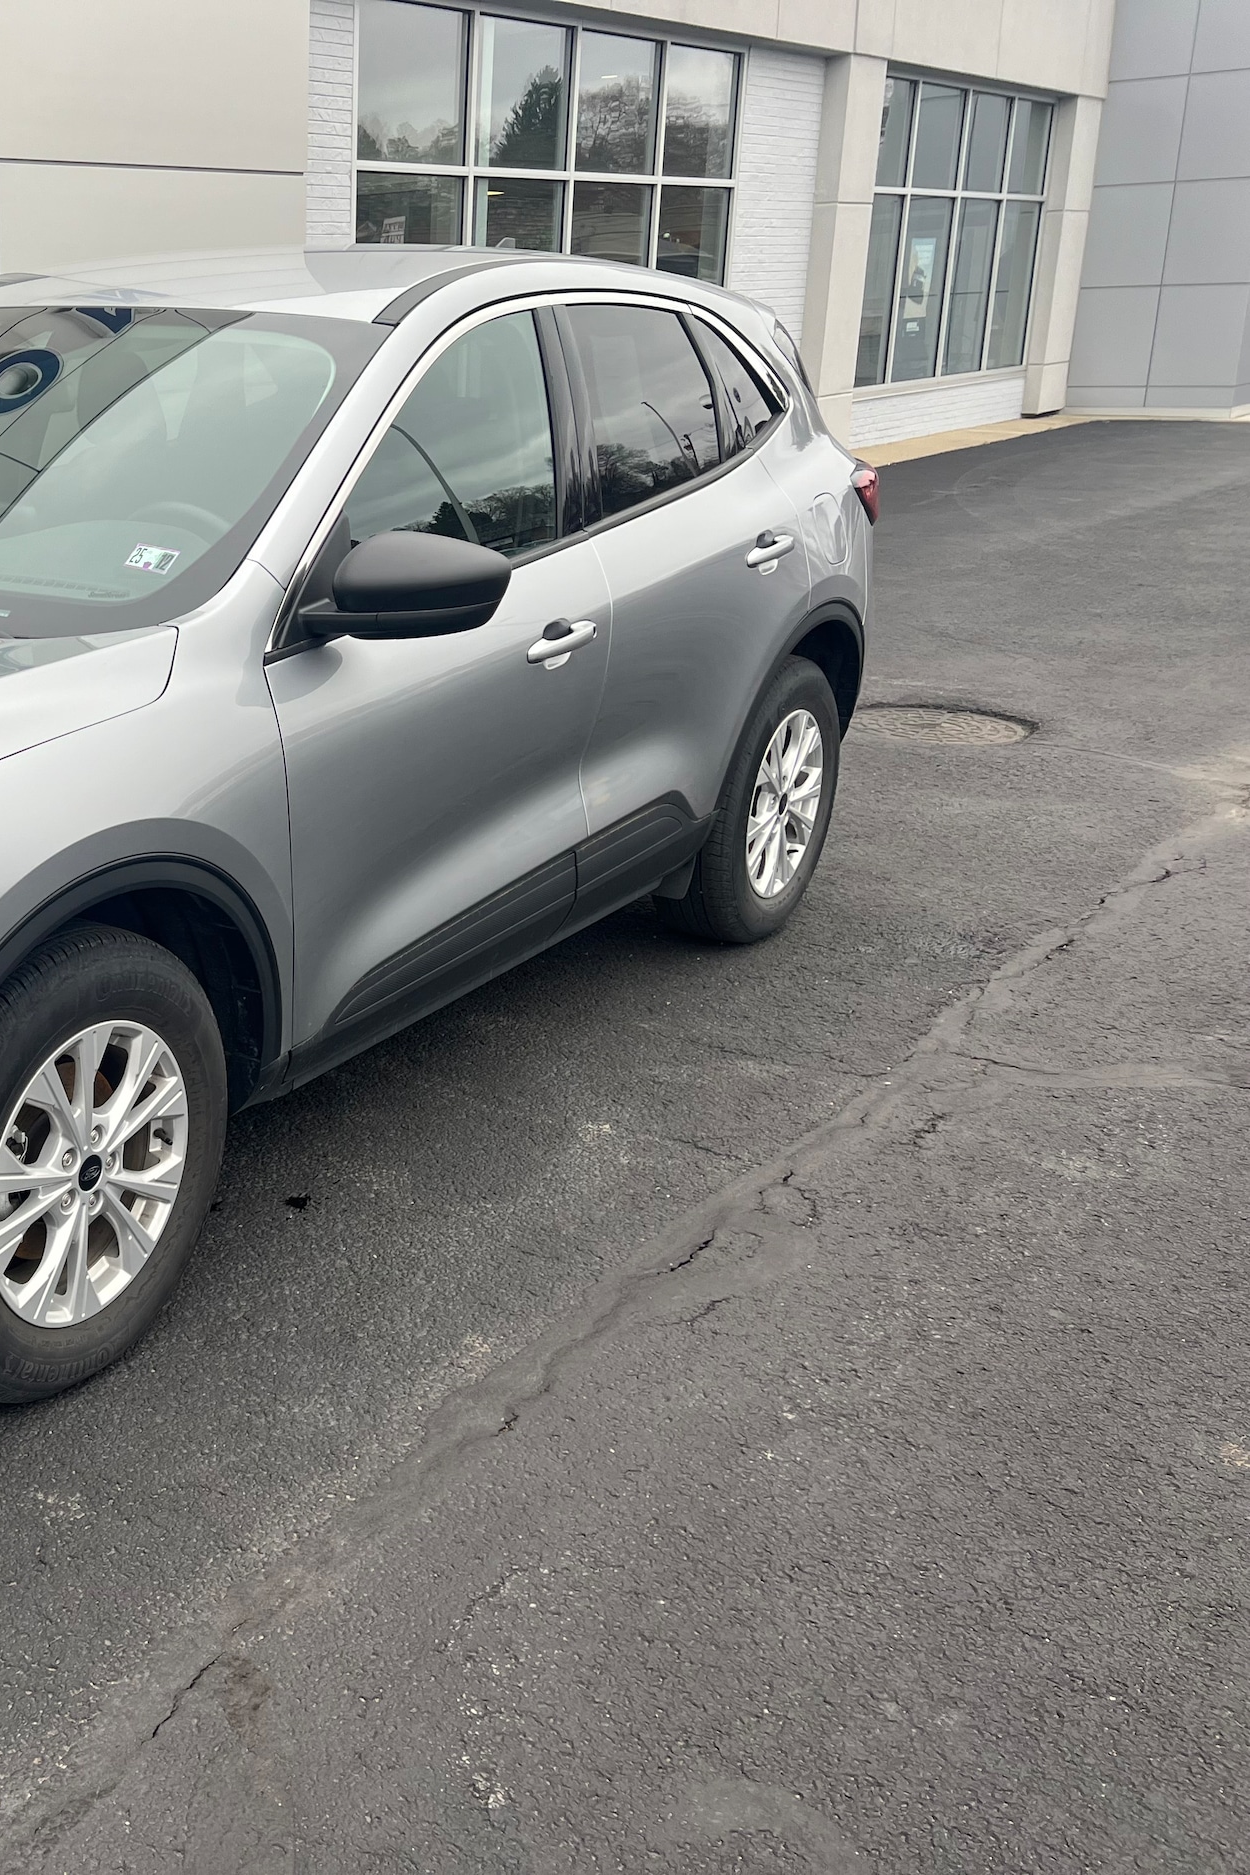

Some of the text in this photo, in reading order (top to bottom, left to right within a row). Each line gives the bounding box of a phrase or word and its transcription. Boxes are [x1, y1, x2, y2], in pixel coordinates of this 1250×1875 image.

[130, 547, 148, 564] 25
[155, 553, 175, 571] 12
[3, 1342, 115, 1382] Continental
